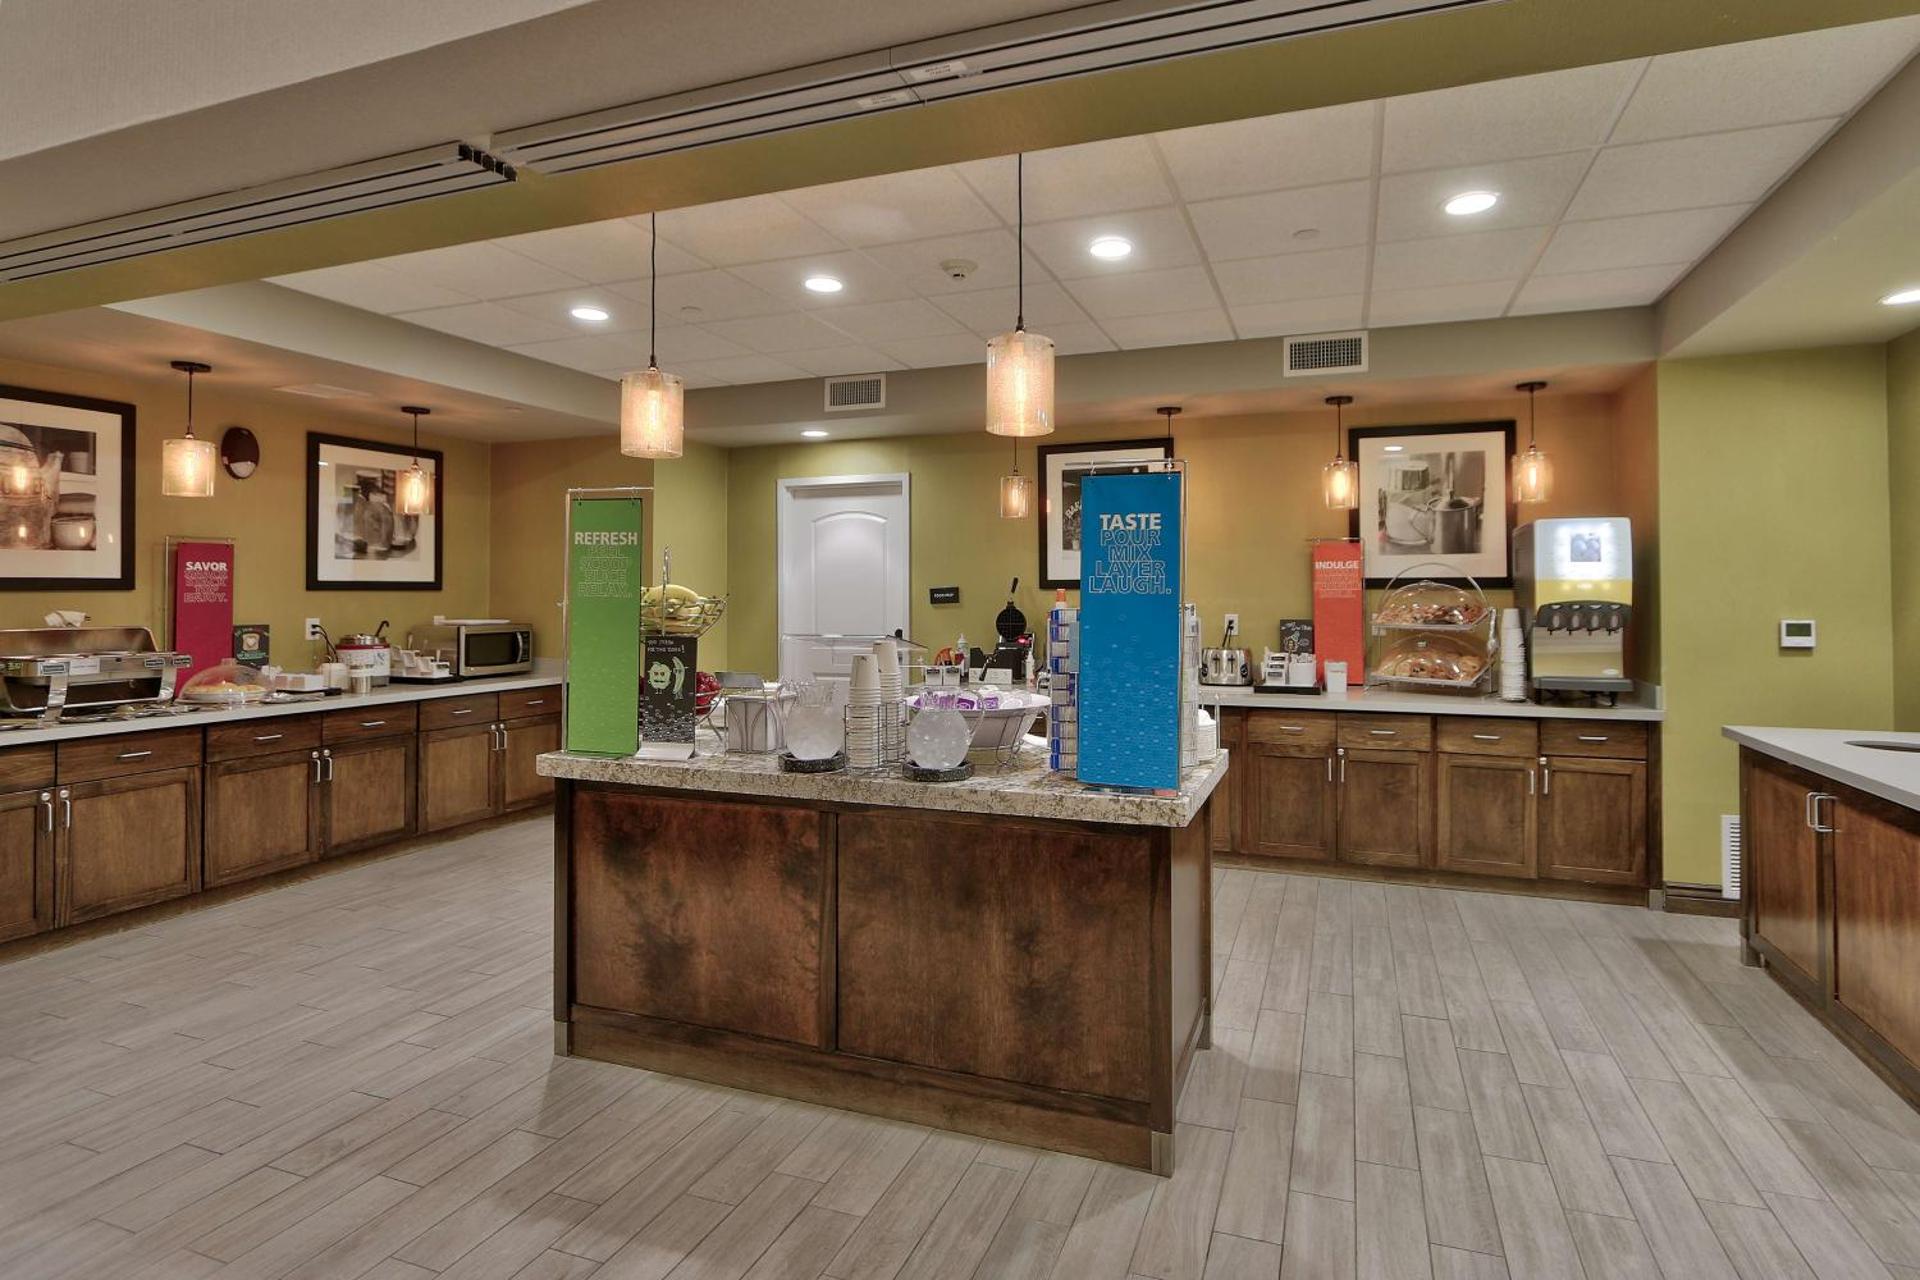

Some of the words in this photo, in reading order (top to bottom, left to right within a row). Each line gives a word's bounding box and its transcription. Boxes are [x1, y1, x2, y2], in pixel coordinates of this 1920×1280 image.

[1099, 513, 1162, 531] TASTE
[574, 531, 638, 546] REFRESH
[1100, 529, 1161, 546] POUR
[1108, 544, 1153, 562] MIX
[186, 561, 228, 571] SAVOR
[1095, 560, 1166, 578] LAYER
[1315, 560, 1360, 569] INDULGE
[1088, 575, 1172, 595] LAUGH.
